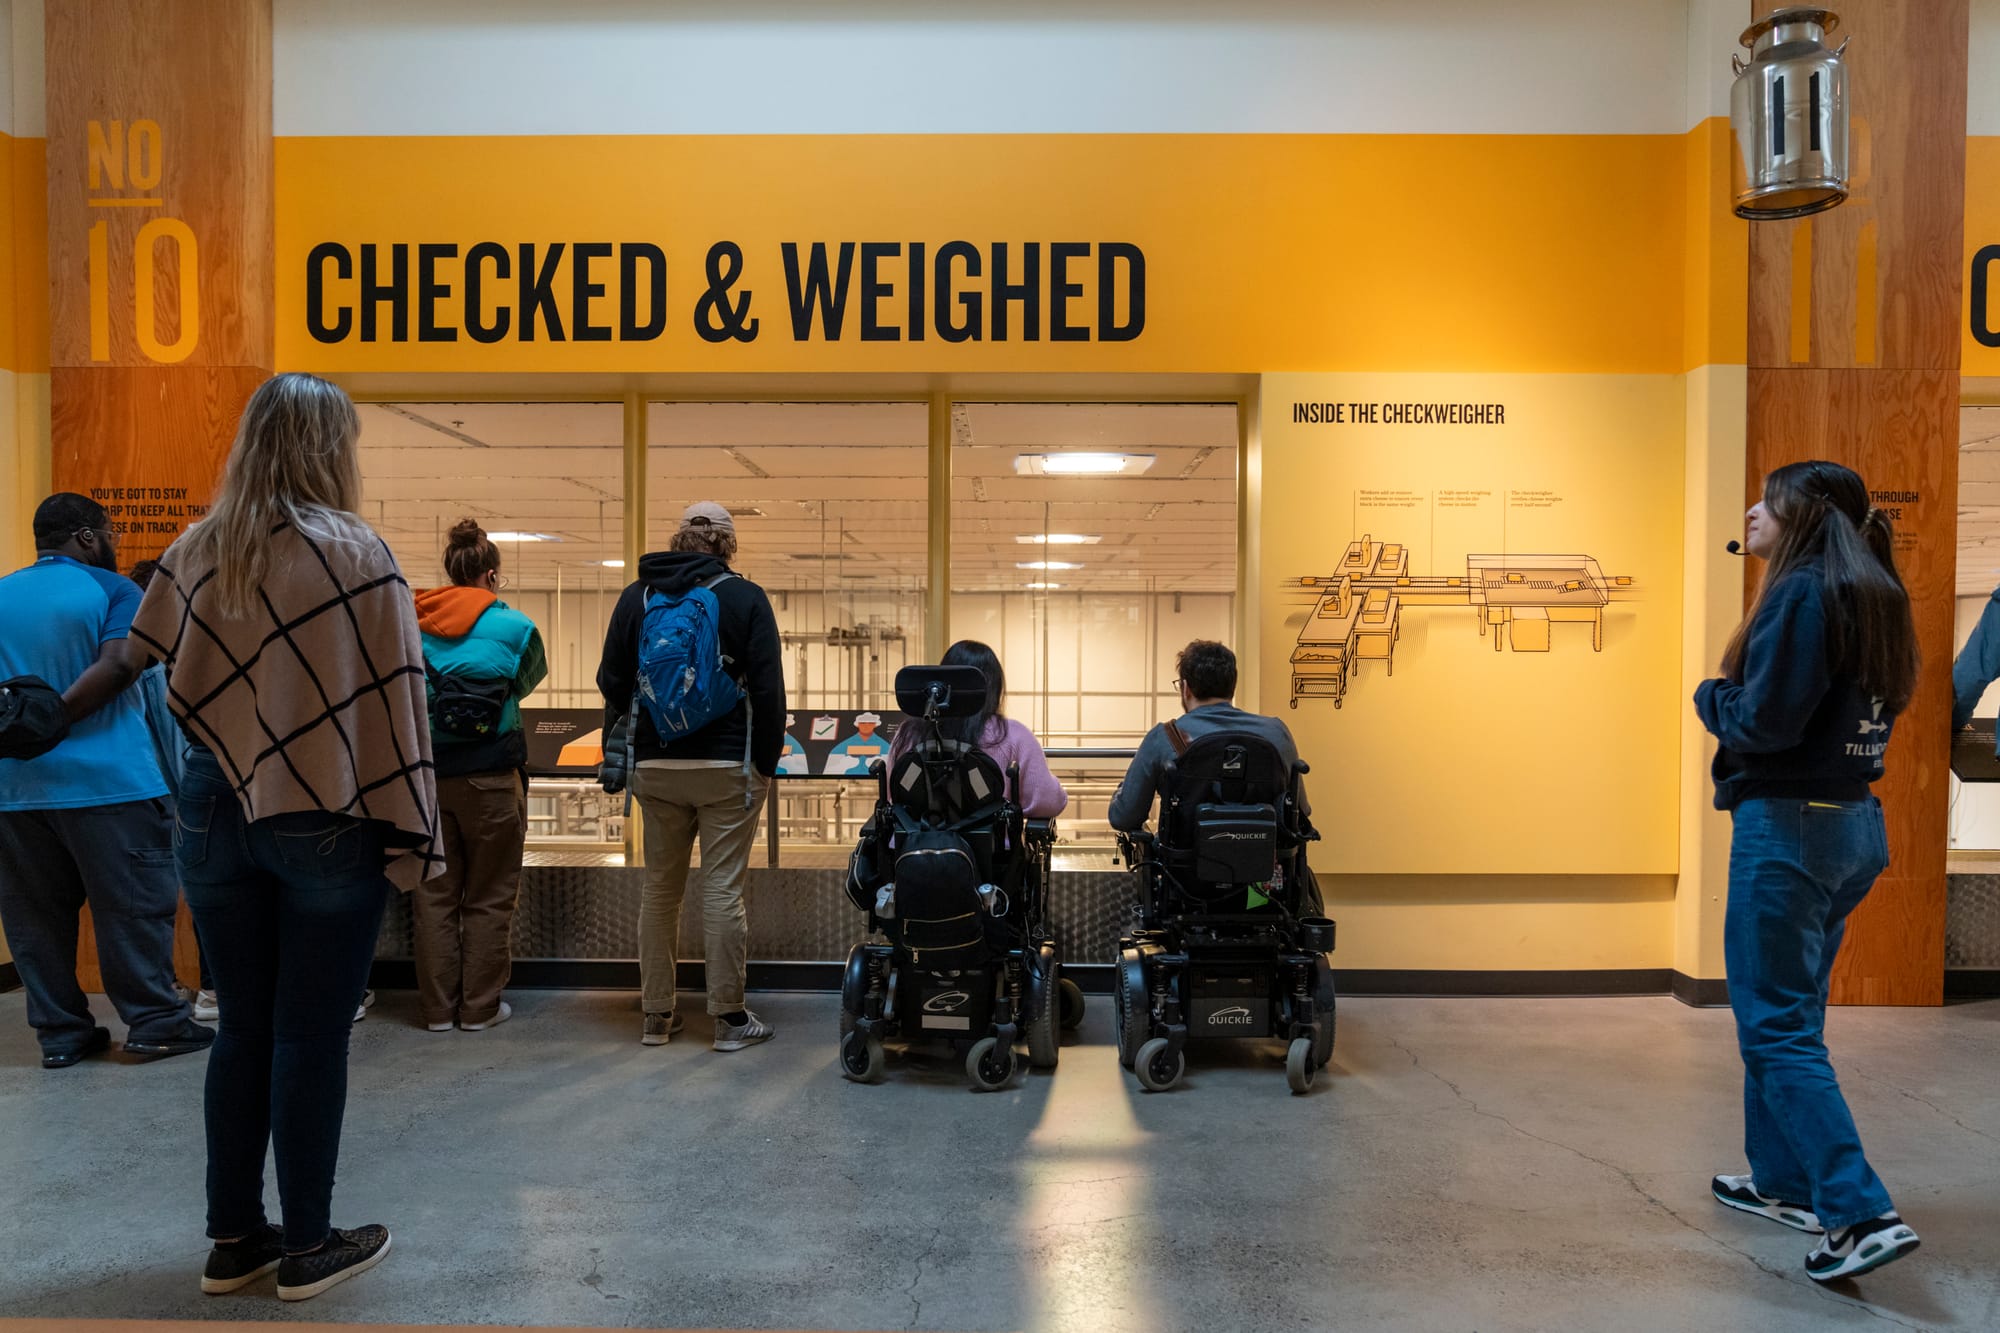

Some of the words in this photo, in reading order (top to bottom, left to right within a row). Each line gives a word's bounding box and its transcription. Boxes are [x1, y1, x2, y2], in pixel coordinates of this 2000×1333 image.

[88, 119, 162, 190] NO
[88, 217, 199, 364] 10
[306, 241, 668, 344] CHECKED
[694, 240, 759, 343] &
[781, 240, 1146, 343] WEIGHED
[1293, 403, 1345, 424] INSIDE
[1349, 403, 1378, 424] THE
[1382, 403, 1505, 425] CHECKWEIGHER
[90, 488, 124, 500] YOU'VE
[127, 488, 146, 500] GOT
[149, 488, 160, 500] TO
[163, 488, 187, 500] STAY
[1870, 491, 1919, 503] THROUGH
[125, 505, 138, 517] TO
[140, 505, 165, 517] KEEP
[167, 505, 184, 517] ALL
[130, 522, 145, 533] ON
[147, 521, 178, 533] TRACK
[1208, 1016, 1253, 1024] QUICKIE
